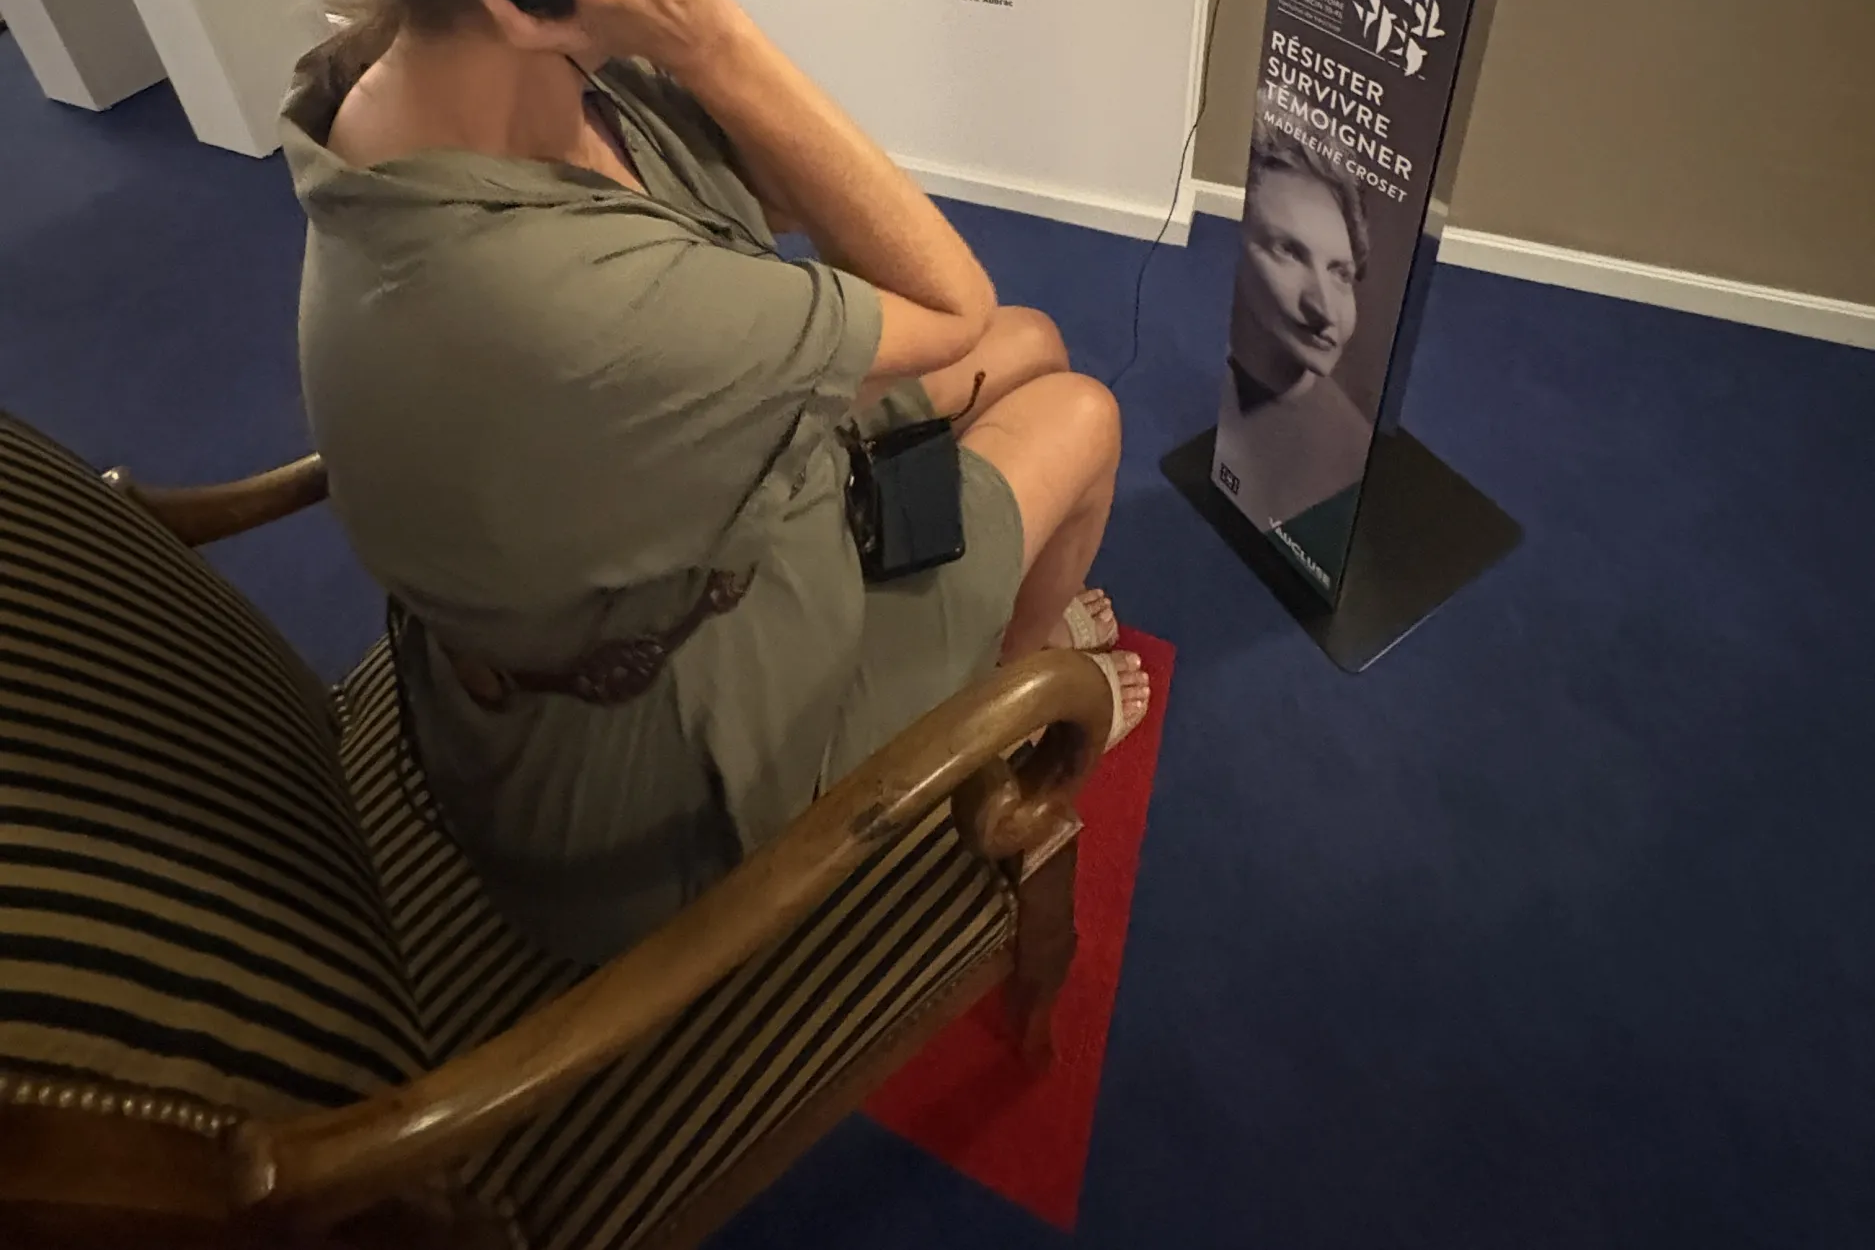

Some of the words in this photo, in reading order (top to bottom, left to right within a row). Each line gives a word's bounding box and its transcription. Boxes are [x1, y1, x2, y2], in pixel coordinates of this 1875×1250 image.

[1267, 55, 1391, 139] SURVIVRE
[1271, 30, 1385, 106] RÉSISTER
[1264, 110, 1344, 166] MADELEINE
[1345, 161, 1407, 203] CROSET
[1265, 79, 1413, 181] TÉMOIGNER
[1268, 516, 1331, 591] VAUCLUSE
